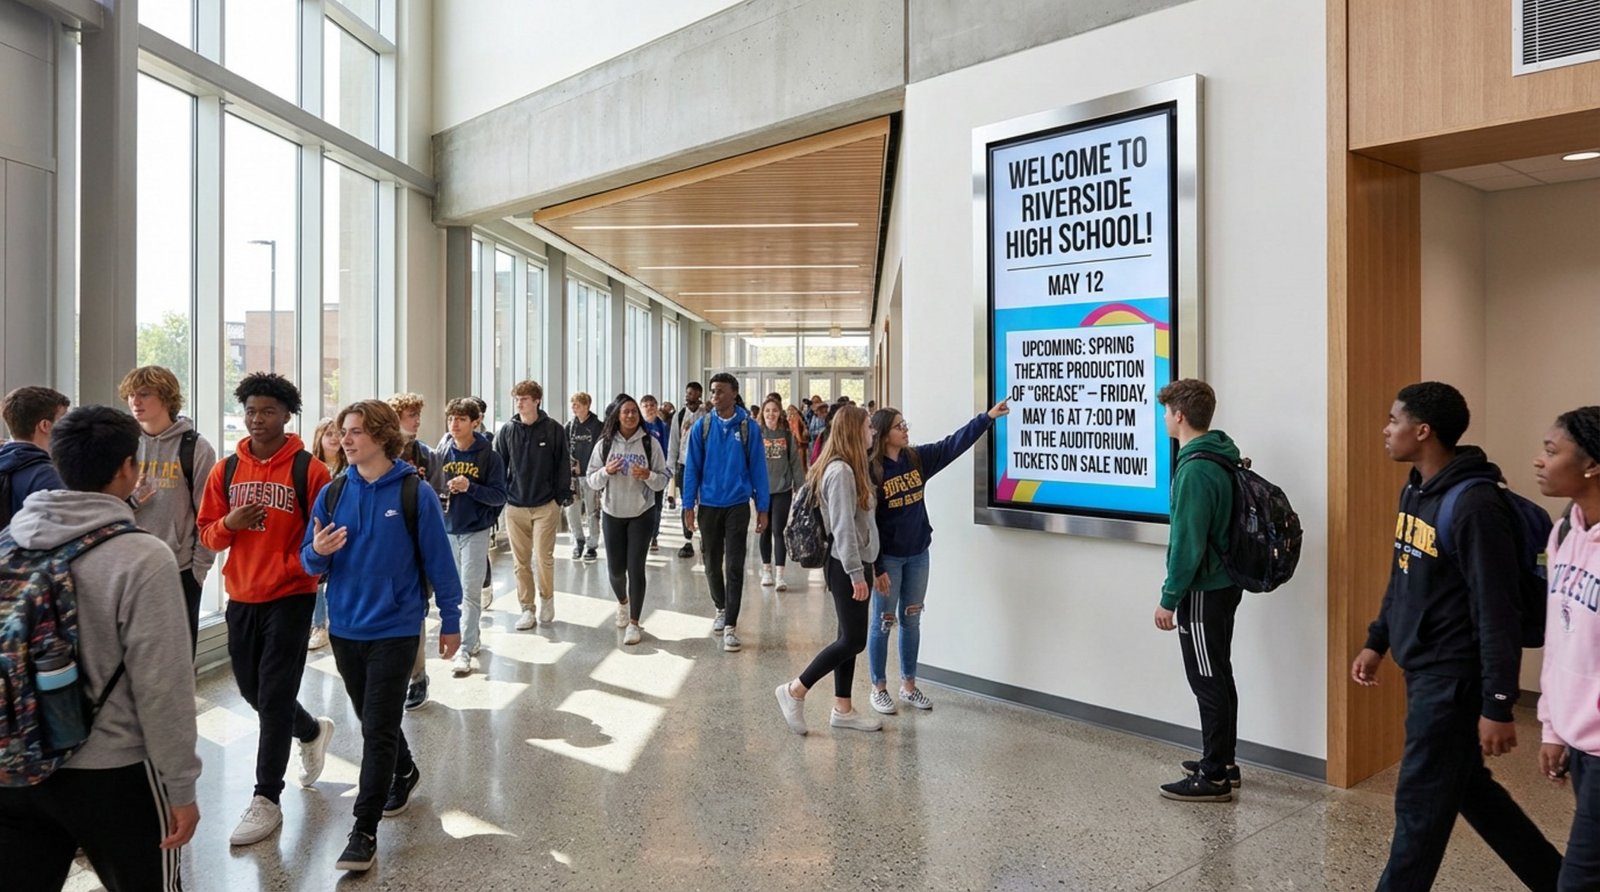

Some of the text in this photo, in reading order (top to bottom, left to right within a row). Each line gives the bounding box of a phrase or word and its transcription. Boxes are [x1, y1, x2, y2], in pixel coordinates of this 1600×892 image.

[1008, 136, 1148, 190] WELCOME TO
[1021, 176, 1133, 223] RIVERSIDE
[1006, 211, 1153, 260] HIGH SCHOOL!
[1048, 270, 1105, 297] MAY 12
[1022, 335, 1135, 358] UPCOMING: SPRING
[1014, 359, 1145, 380] THEATRE PRODUCTION
[1011, 385, 1026, 403] OF
[1100, 384, 1148, 405] FRIDAY,
[1022, 408, 1136, 427] MAY 16 AT 7:00 PM
[1020, 430, 1139, 452] IN THE AUDITORIUM.
[1013, 451, 1148, 476] TICKETS ON SALE NOW!
